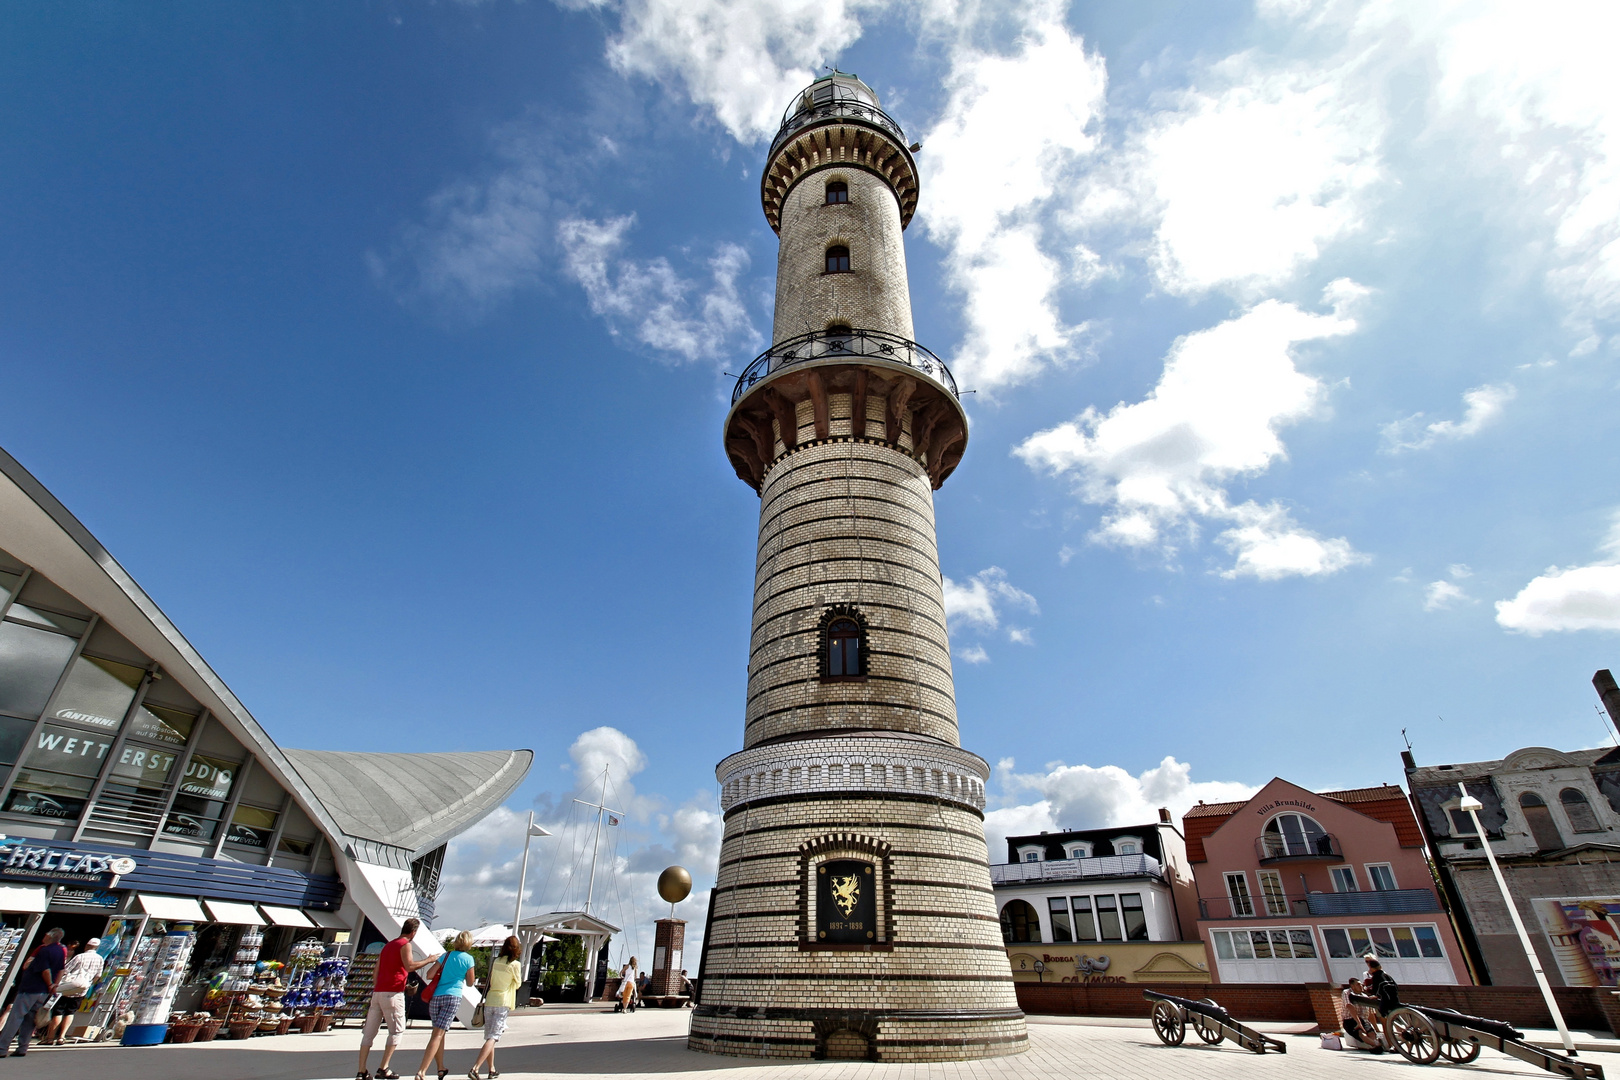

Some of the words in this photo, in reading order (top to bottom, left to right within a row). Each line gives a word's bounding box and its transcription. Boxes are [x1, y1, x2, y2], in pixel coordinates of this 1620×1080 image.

[61, 711, 117, 727] ANTENNE
[164, 735, 180, 743] MHz
[184, 784, 227, 798] ANTENNE
[11, 804, 34, 812] MV
[32, 806, 69, 817] EVENT
[1257, 804, 1275, 816] Villa
[1274, 799, 1316, 812] Brunhilde
[166, 825, 182, 833] MV
[182, 827, 207, 837] EVENT
[240, 837, 262, 846] EVENT
[3, 867, 52, 878] GRIECHISCHE
[55, 889, 95, 898] Maritim
[829, 922, 844, 930] 1897
[849, 922, 863, 930] 1898
[1042, 954, 1075, 963] BODEGA
